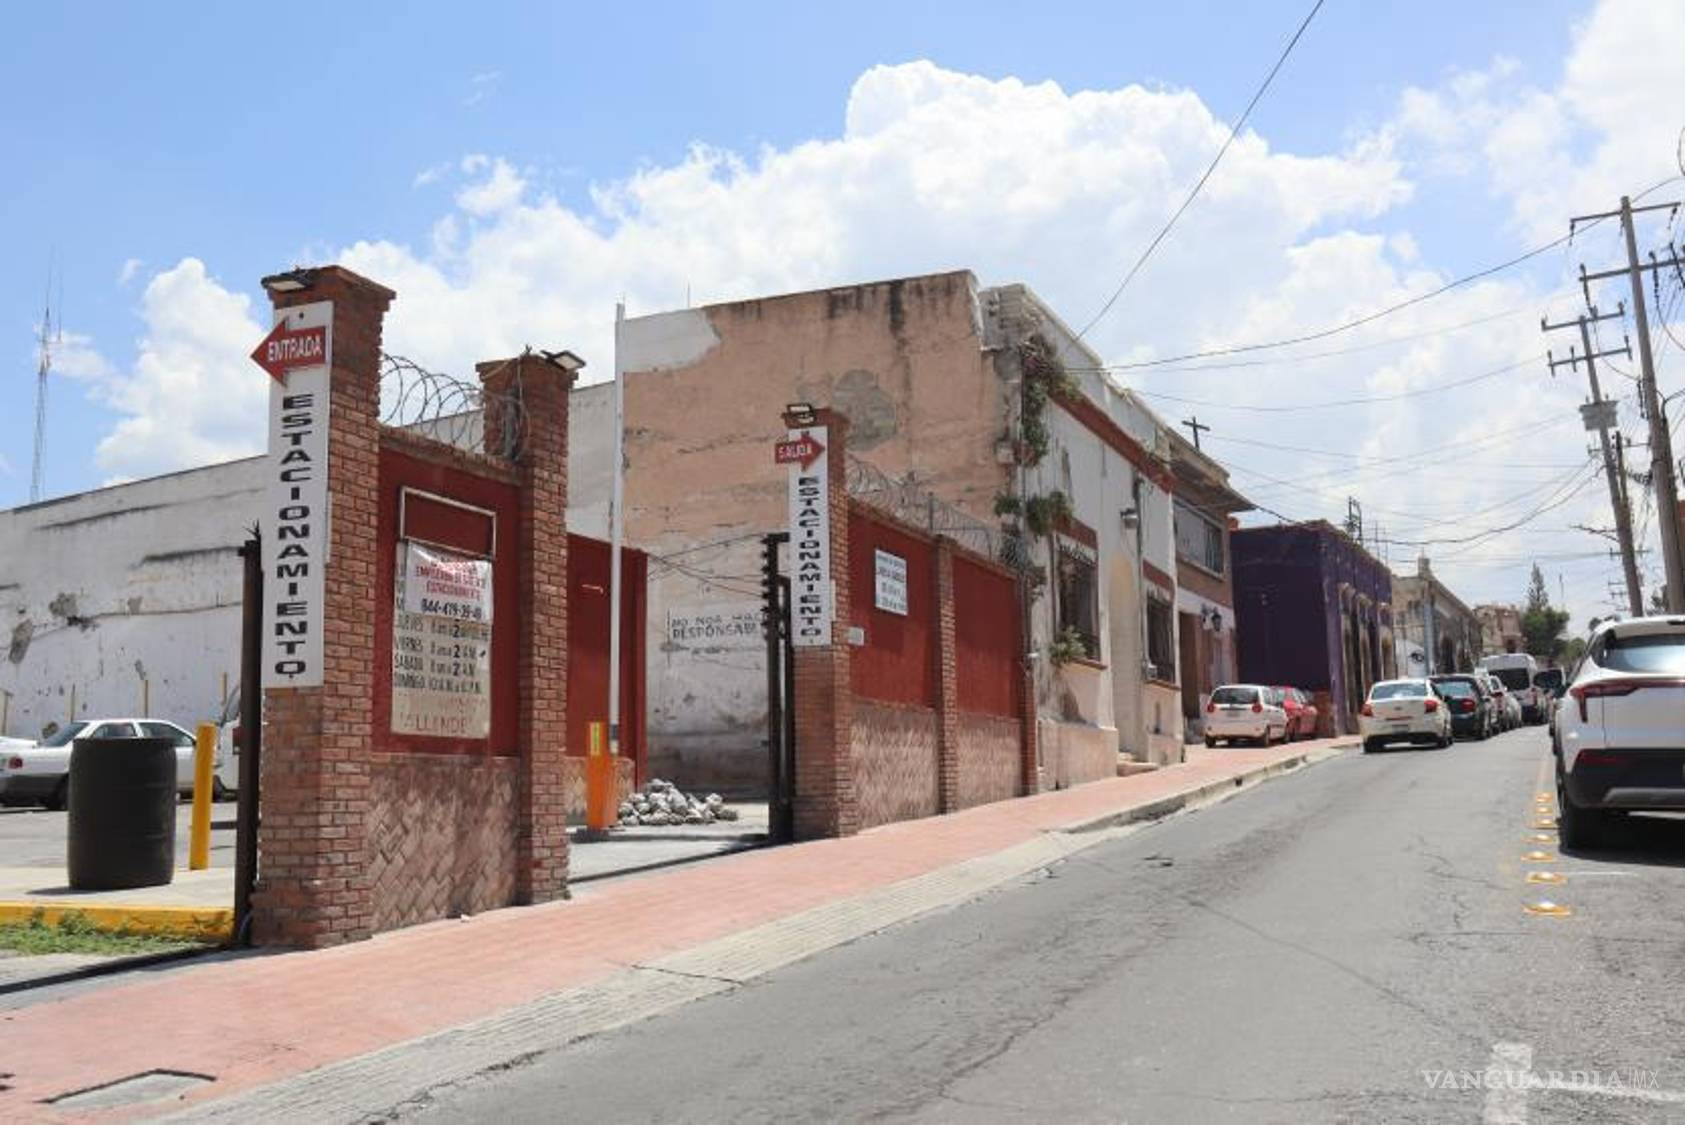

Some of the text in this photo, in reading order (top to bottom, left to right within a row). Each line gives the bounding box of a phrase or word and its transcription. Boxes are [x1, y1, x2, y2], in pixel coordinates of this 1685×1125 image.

[268, 334, 322, 361] ENTRADA
[275, 394, 313, 674] ESTACIONAMIENTO
[799, 477, 821, 636] ESTACIONAMIENTO
[453, 624, 460, 638] 2
[453, 644, 460, 658] 2
[453, 661, 460, 676] 2
